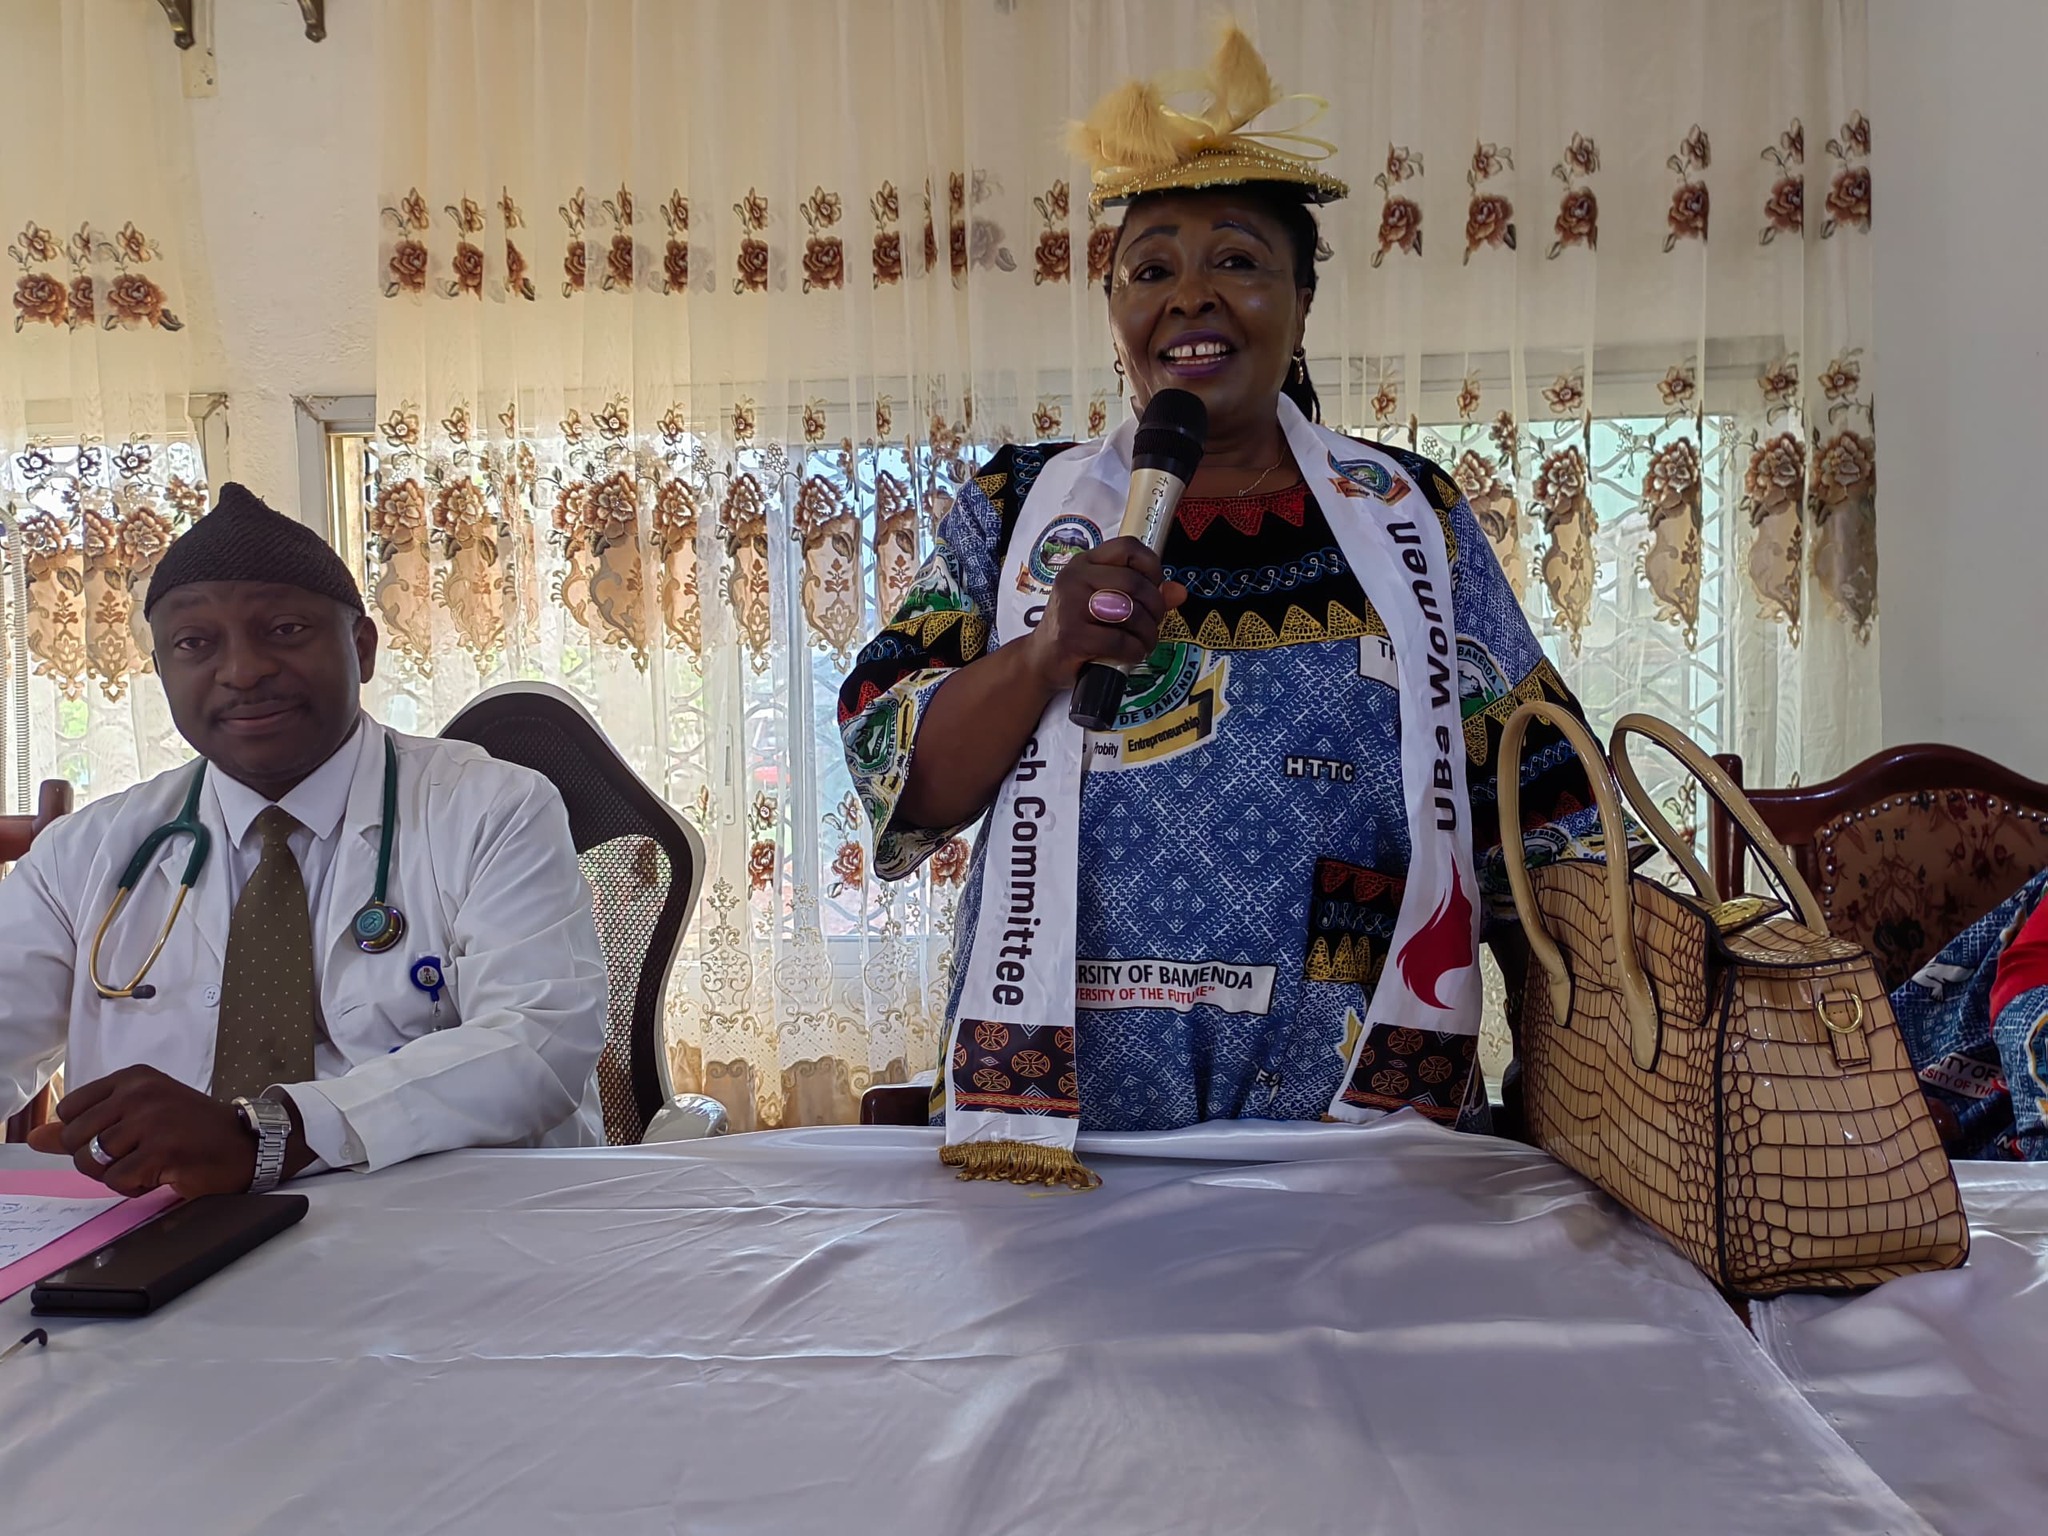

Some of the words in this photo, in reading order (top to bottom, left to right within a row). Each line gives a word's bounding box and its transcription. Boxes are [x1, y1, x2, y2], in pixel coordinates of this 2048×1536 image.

[1386, 521, 1451, 709] Women
[1119, 713, 1141, 726] DE
[1143, 660, 1200, 721] BAMENDA
[1127, 715, 1201, 753] Entrepreneurship
[1285, 756, 1354, 782] HTTC
[1433, 725, 1457, 832] UBa
[992, 796, 1046, 1007] Committee
[1076, 964, 1122, 985] RSITY
[1128, 964, 1154, 985] OF
[1158, 965, 1253, 990] BAMENDA
[1119, 987, 1136, 1001] OF
[1139, 987, 1164, 1001] THE
[1953, 1079, 1972, 1091] OF
